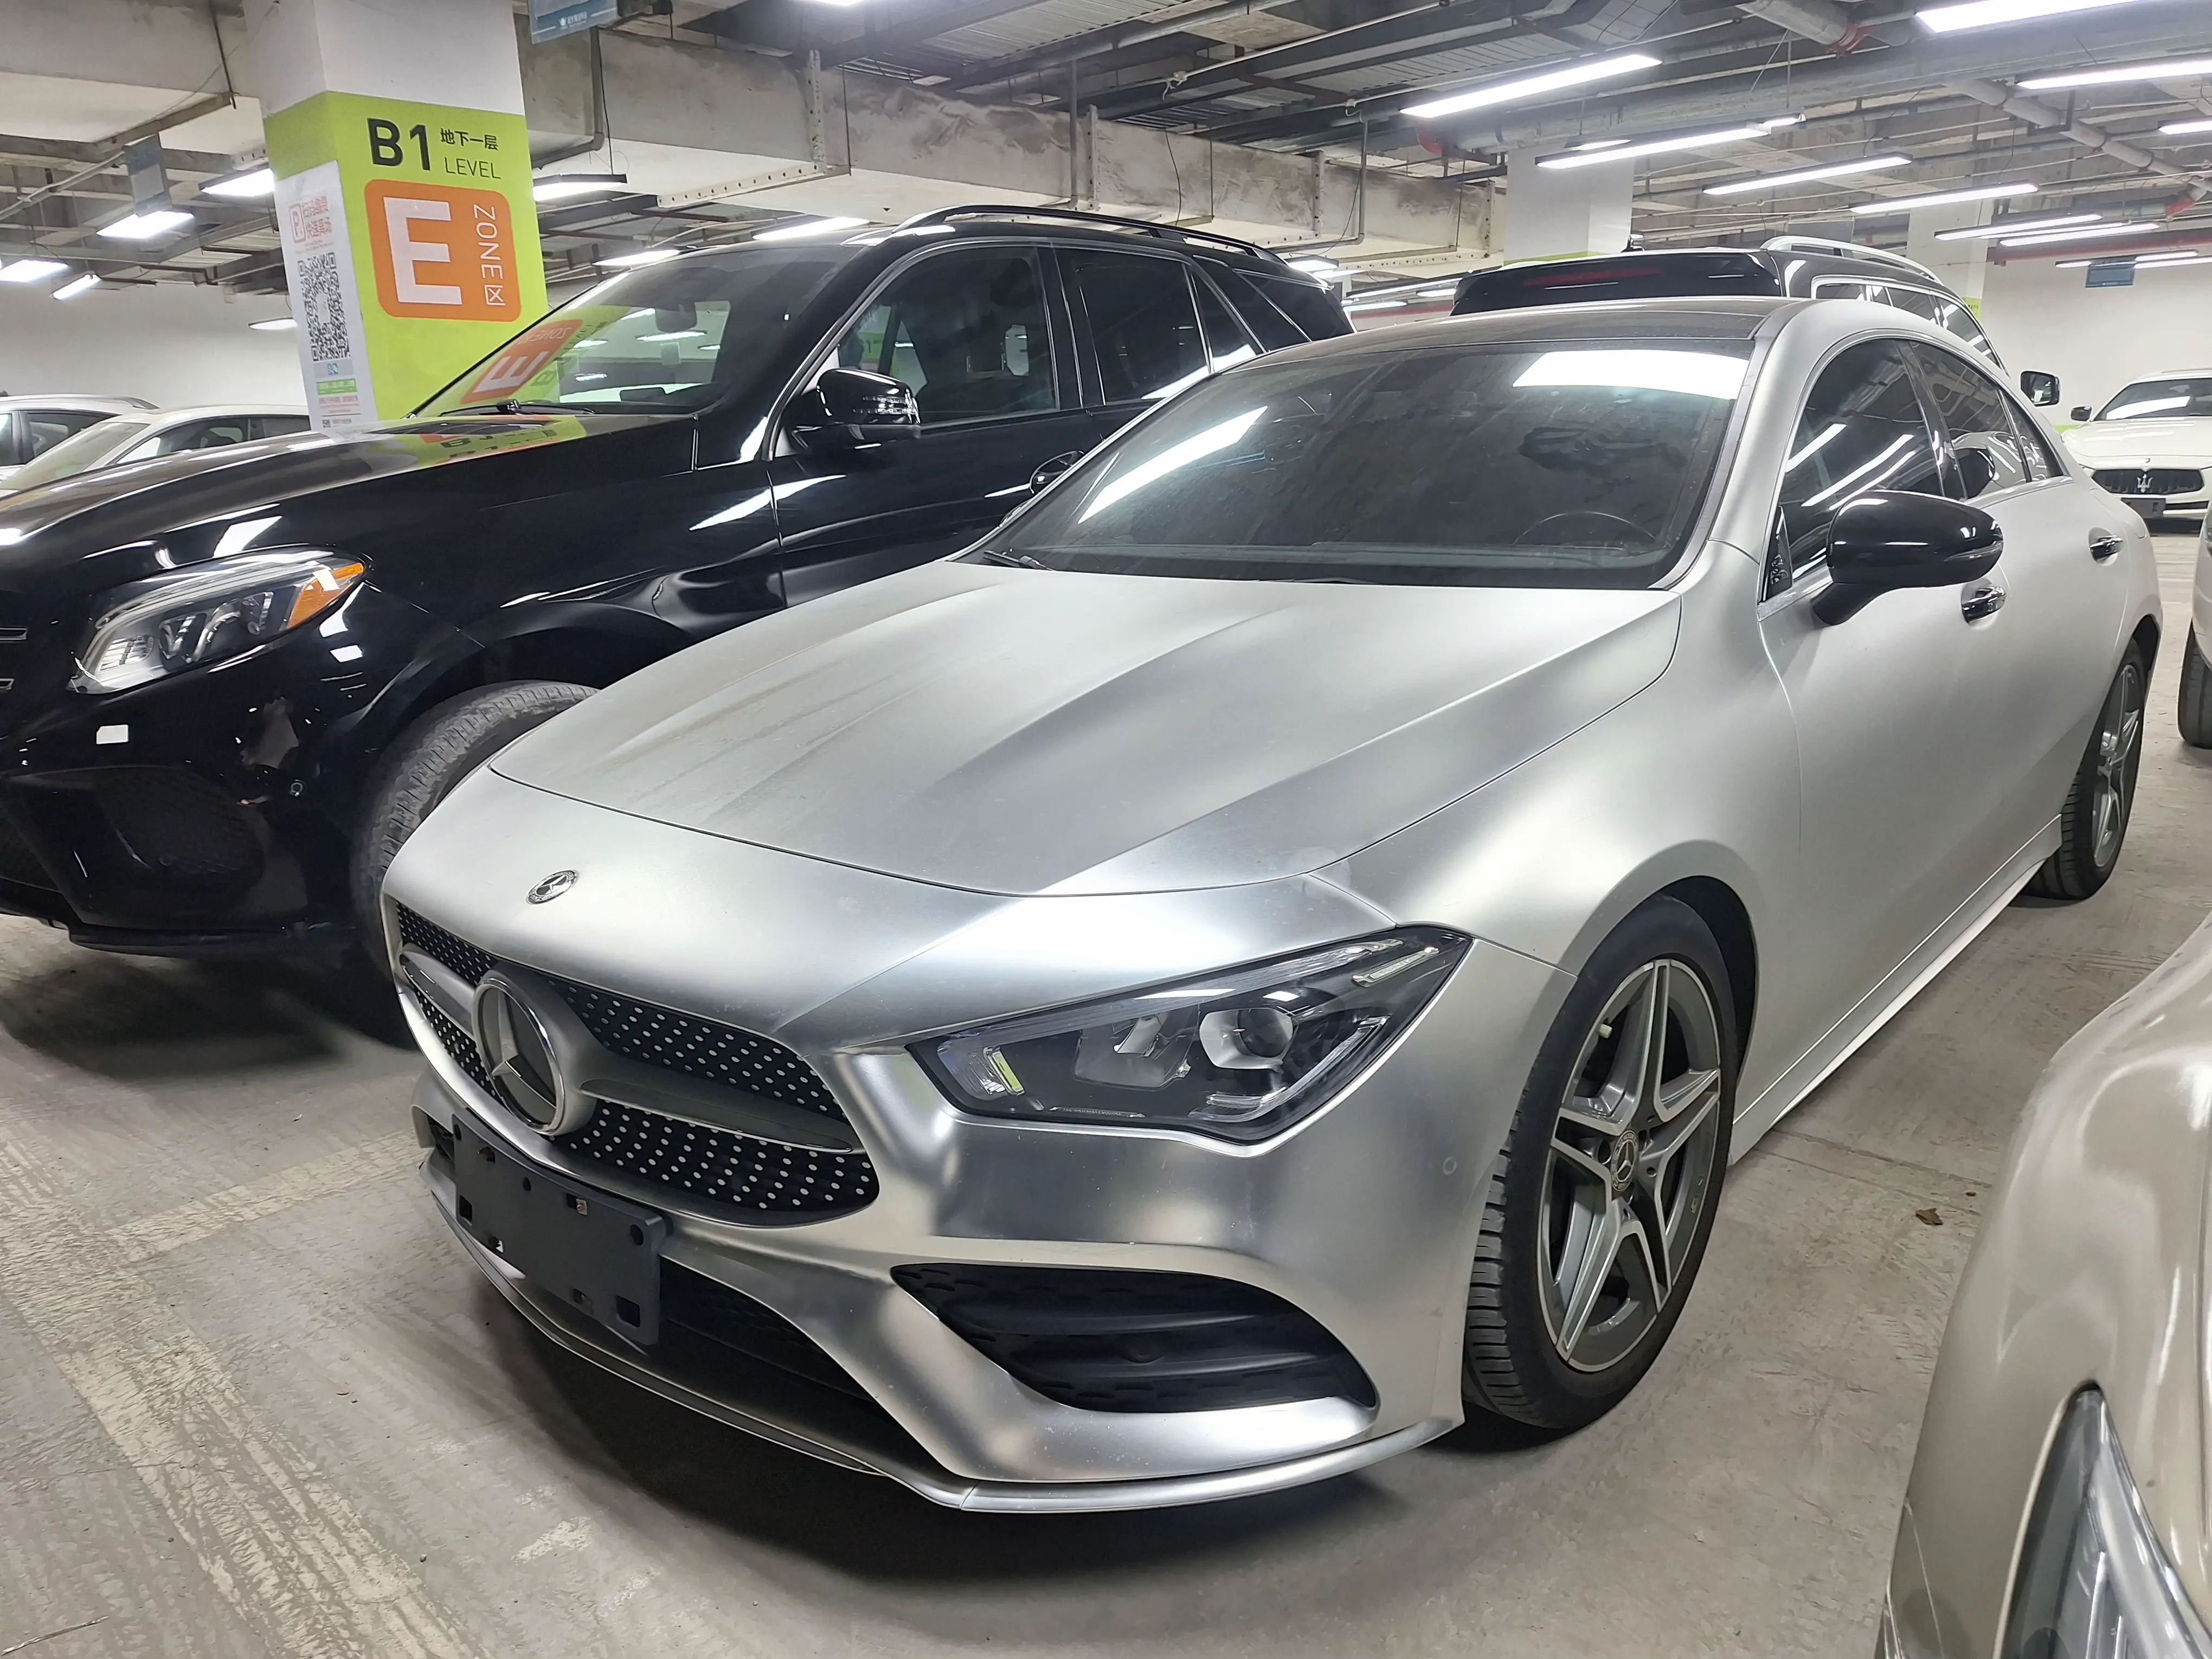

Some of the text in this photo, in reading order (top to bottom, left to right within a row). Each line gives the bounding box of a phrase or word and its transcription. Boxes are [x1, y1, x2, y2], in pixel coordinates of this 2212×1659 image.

[367, 118, 431, 171] B1
[440, 127, 498, 151] 地下一层
[444, 156, 501, 179] LEVEL
[383, 196, 462, 305] E
[473, 203, 506, 306] ZONE 区
